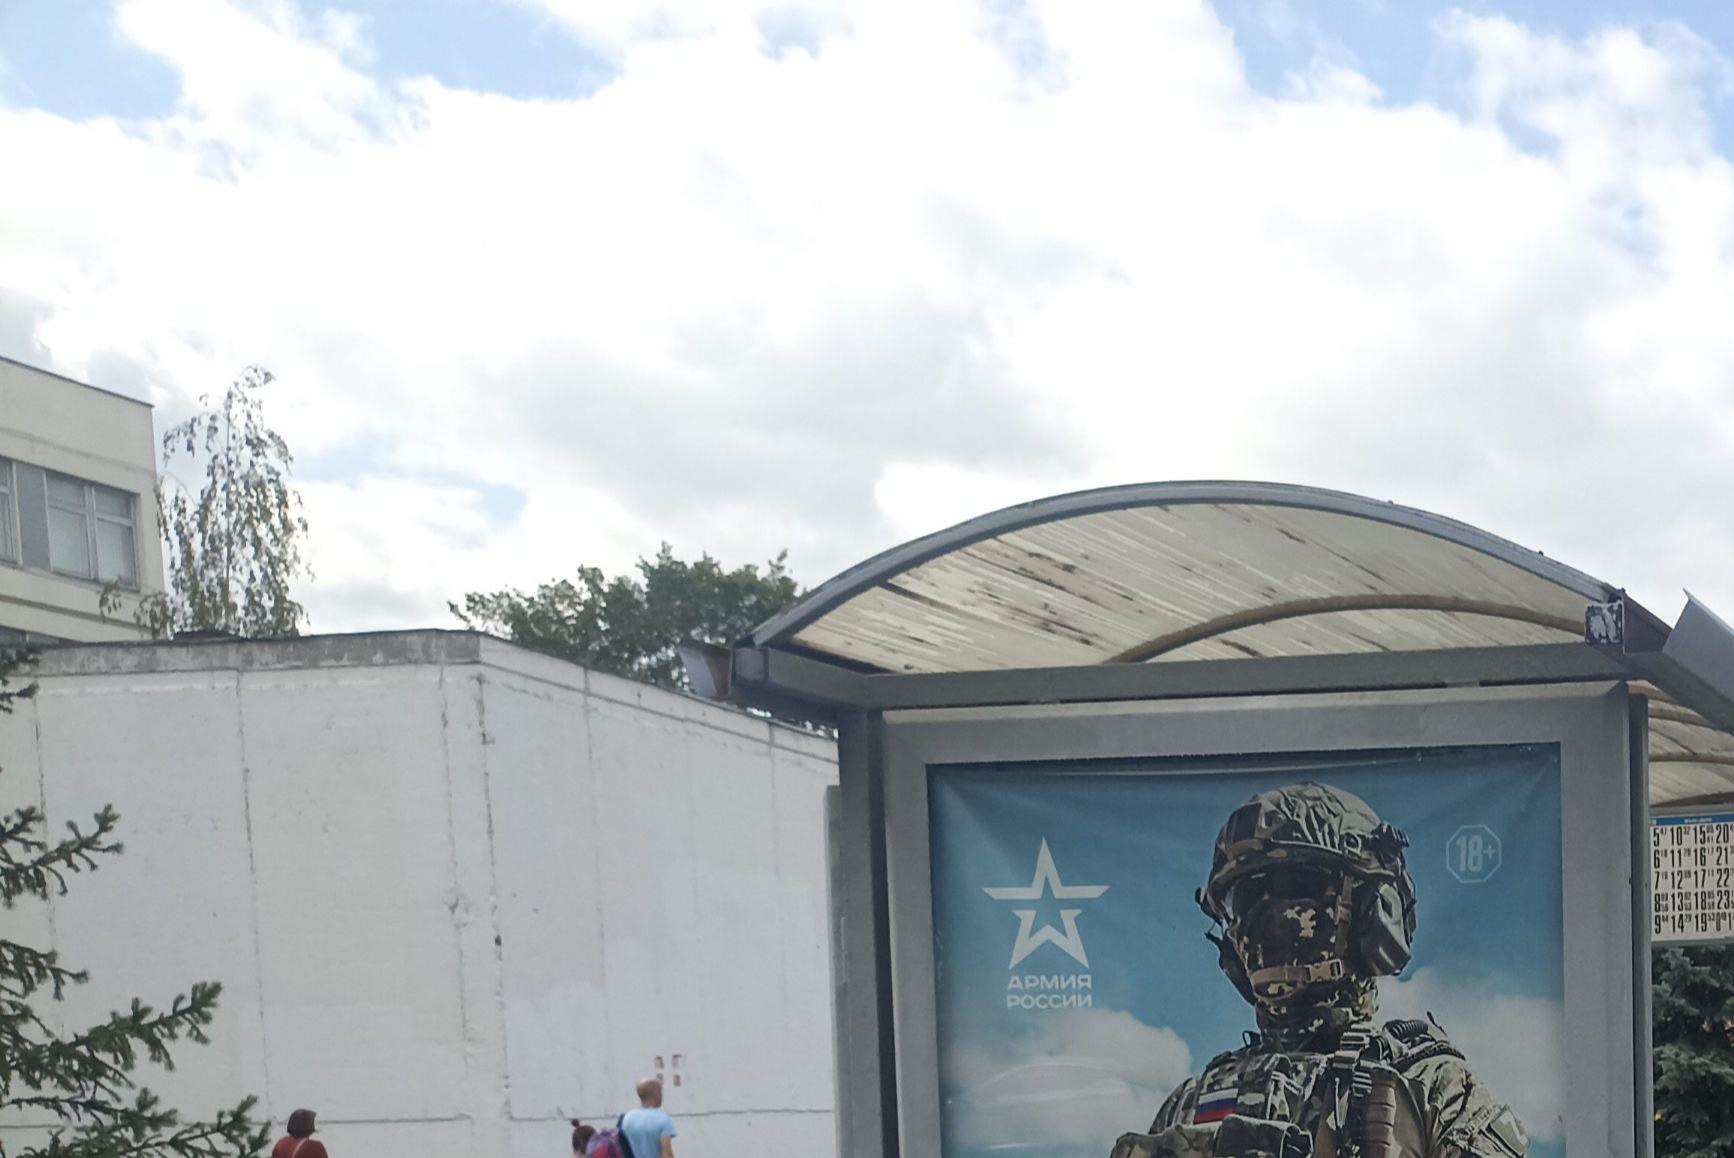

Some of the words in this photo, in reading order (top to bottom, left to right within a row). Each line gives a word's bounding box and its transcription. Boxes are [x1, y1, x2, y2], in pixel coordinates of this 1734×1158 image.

[1653, 827, 1660, 847] 5
[1670, 826, 1682, 846] 10
[1693, 825, 1706, 845] 15
[1716, 824, 1729, 844] 20
[1456, 834, 1497, 873] 18+
[1653, 849, 1660, 869] 6
[1670, 848, 1682, 868] 11
[1693, 847, 1706, 867] 16
[1716, 846, 1728, 866] 21
[1652, 871, 1660, 890] 7
[1671, 870, 1683, 889] 12
[1694, 869, 1706, 889] 17
[1716, 867, 1730, 888] 22
[1654, 893, 1661, 912] 8
[1671, 892, 1683, 912] 13
[1694, 891, 1707, 910] 18
[1716, 889, 1730, 910] 23
[1654, 914, 1661, 934] 9
[1671, 913, 1684, 933] 14
[1695, 912, 1707, 933] 19
[1007, 974, 1092, 991] АРМИЯ
[1006, 994, 1093, 1009] РОССИИ
